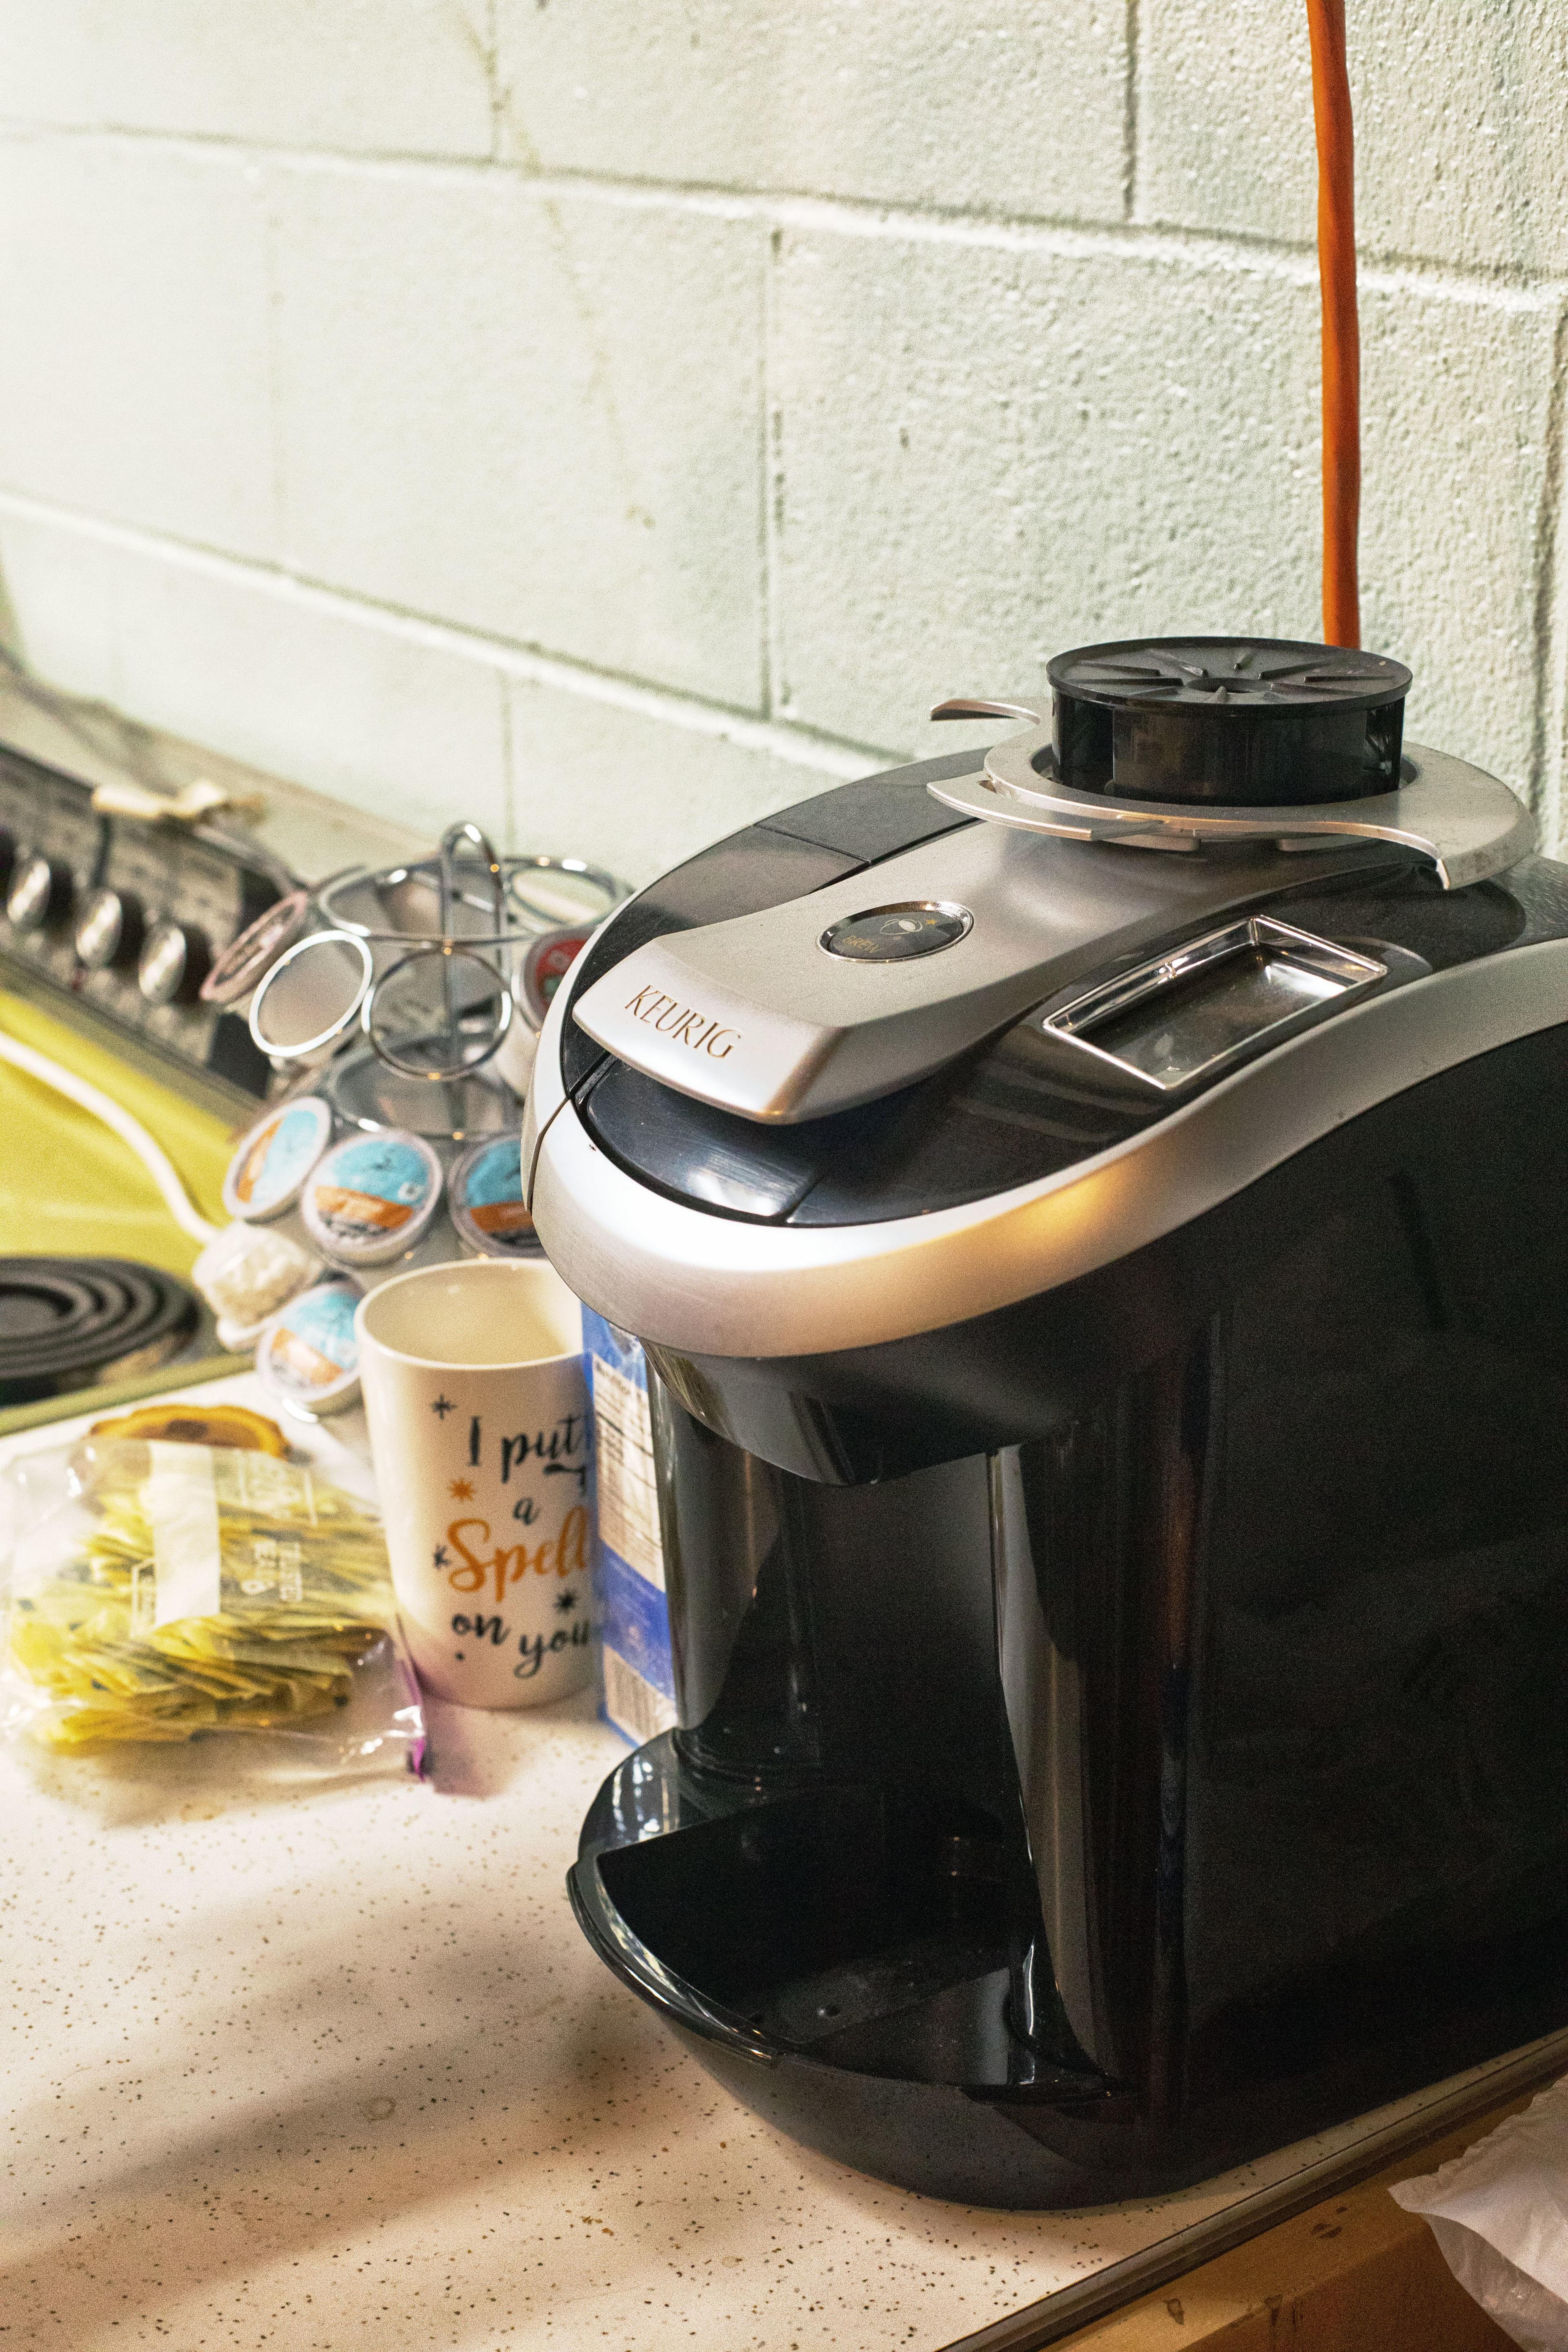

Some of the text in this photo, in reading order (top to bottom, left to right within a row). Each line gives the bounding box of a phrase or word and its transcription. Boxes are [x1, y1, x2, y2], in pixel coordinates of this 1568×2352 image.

[624, 984, 742, 1058] KEURIG
[466, 1413, 587, 1485] I put
[513, 1497, 541, 1526] a
[447, 1506, 587, 1603] Spell
[451, 1613, 590, 1679] on you
